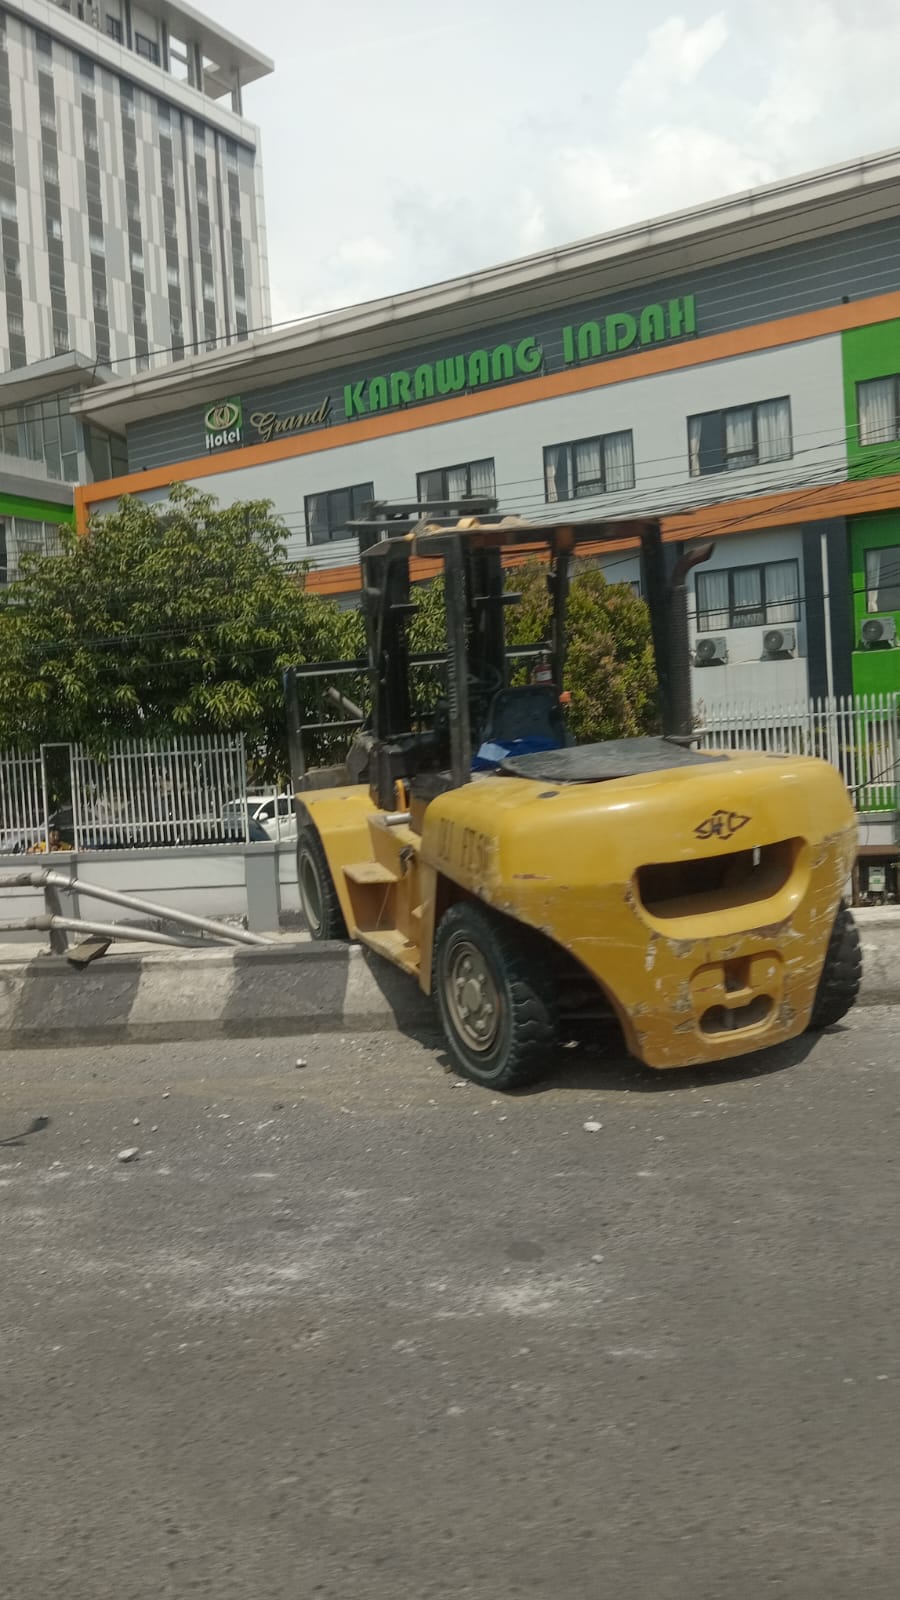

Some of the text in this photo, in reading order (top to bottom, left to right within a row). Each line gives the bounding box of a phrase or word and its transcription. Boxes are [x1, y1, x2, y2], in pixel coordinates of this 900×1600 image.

[250, 294, 696, 442] Grand KARAWANG INDAH
[205, 427, 241, 449] Hotel
